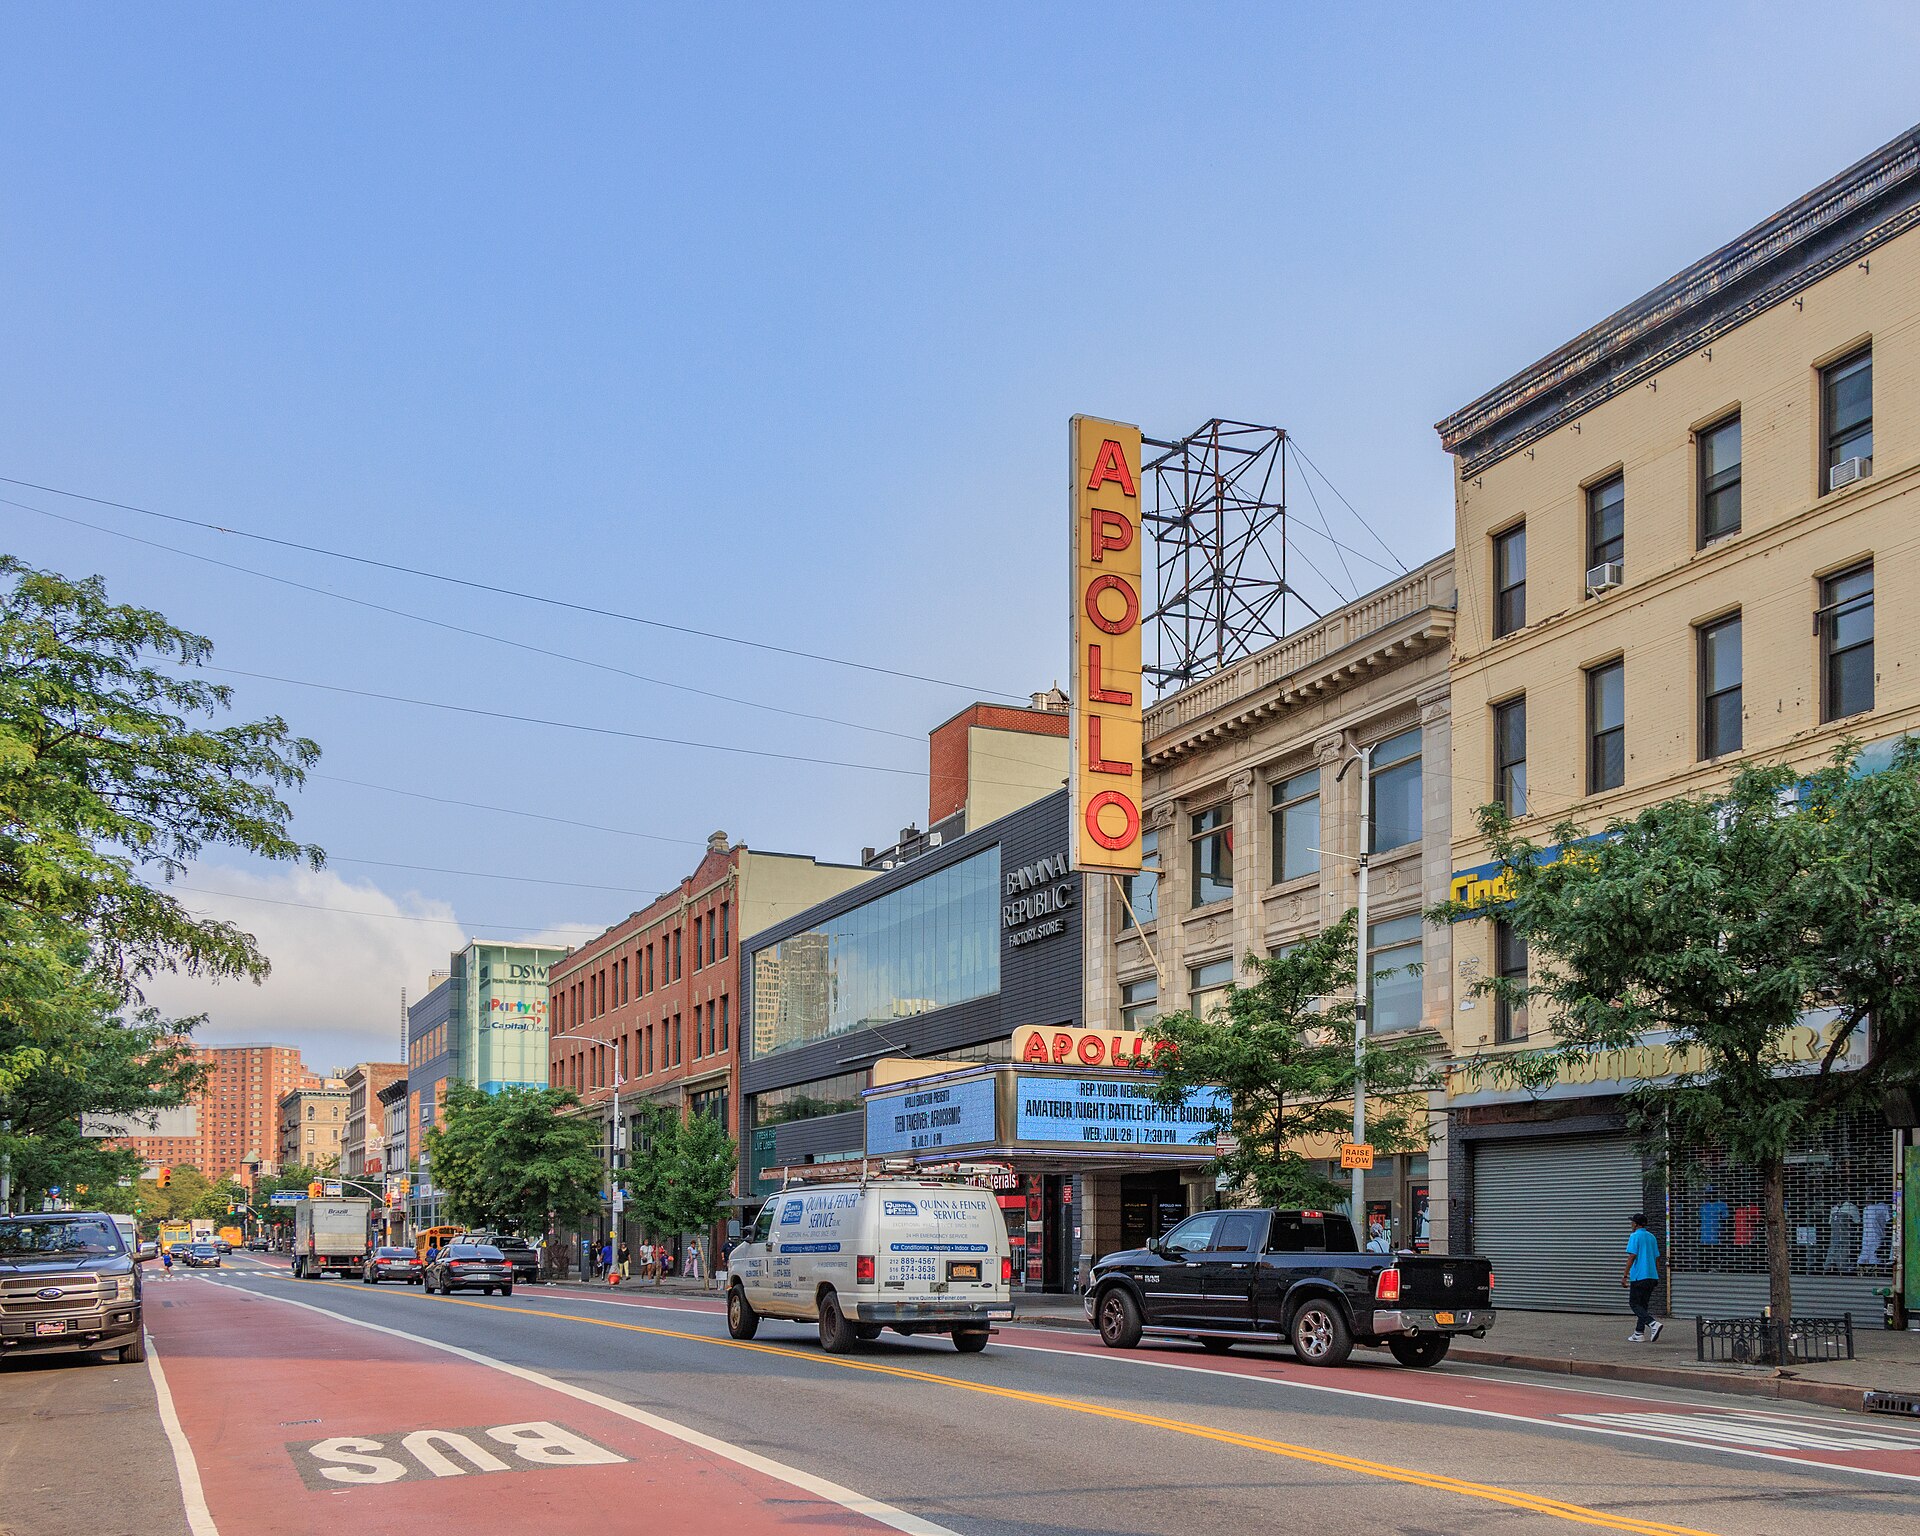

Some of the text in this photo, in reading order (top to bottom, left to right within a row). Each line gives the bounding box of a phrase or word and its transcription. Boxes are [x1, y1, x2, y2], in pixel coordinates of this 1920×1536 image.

[1087, 439, 1139, 850] APOLLO
[1006, 853, 1067, 895] BANANA
[1003, 884, 1071, 928] REPUBLIC
[1009, 919, 1064, 947] FACTORY STORE
[510, 964, 549, 979] DSW
[491, 998, 548, 1014] Party Ci
[491, 1022, 527, 1030] Capital
[1080, 1083, 1095, 1096] REP
[1097, 1084, 1118, 1098] YOUR
[1025, 1100, 1073, 1117] AMATEUR
[1075, 1102, 1105, 1120] NIGHT
[1108, 1104, 1143, 1121] BATTLE
[1144, 1104, 1158, 1121] OF
[1159, 1105, 1177, 1122] THE
[1104, 1128, 1119, 1141] JUL
[1144, 1129, 1162, 1143] 7:30
[1164, 1129, 1177, 1143] PM
[806, 1196, 827, 1214] QUINN
[834, 1194, 859, 1209] FEINER
[920, 1200, 987, 1210] QUINN & FEINER
[808, 1213, 834, 1228] SERVICE
[934, 1211, 966, 1220] SERVICE
[308, 1420, 630, 1484] BUS
